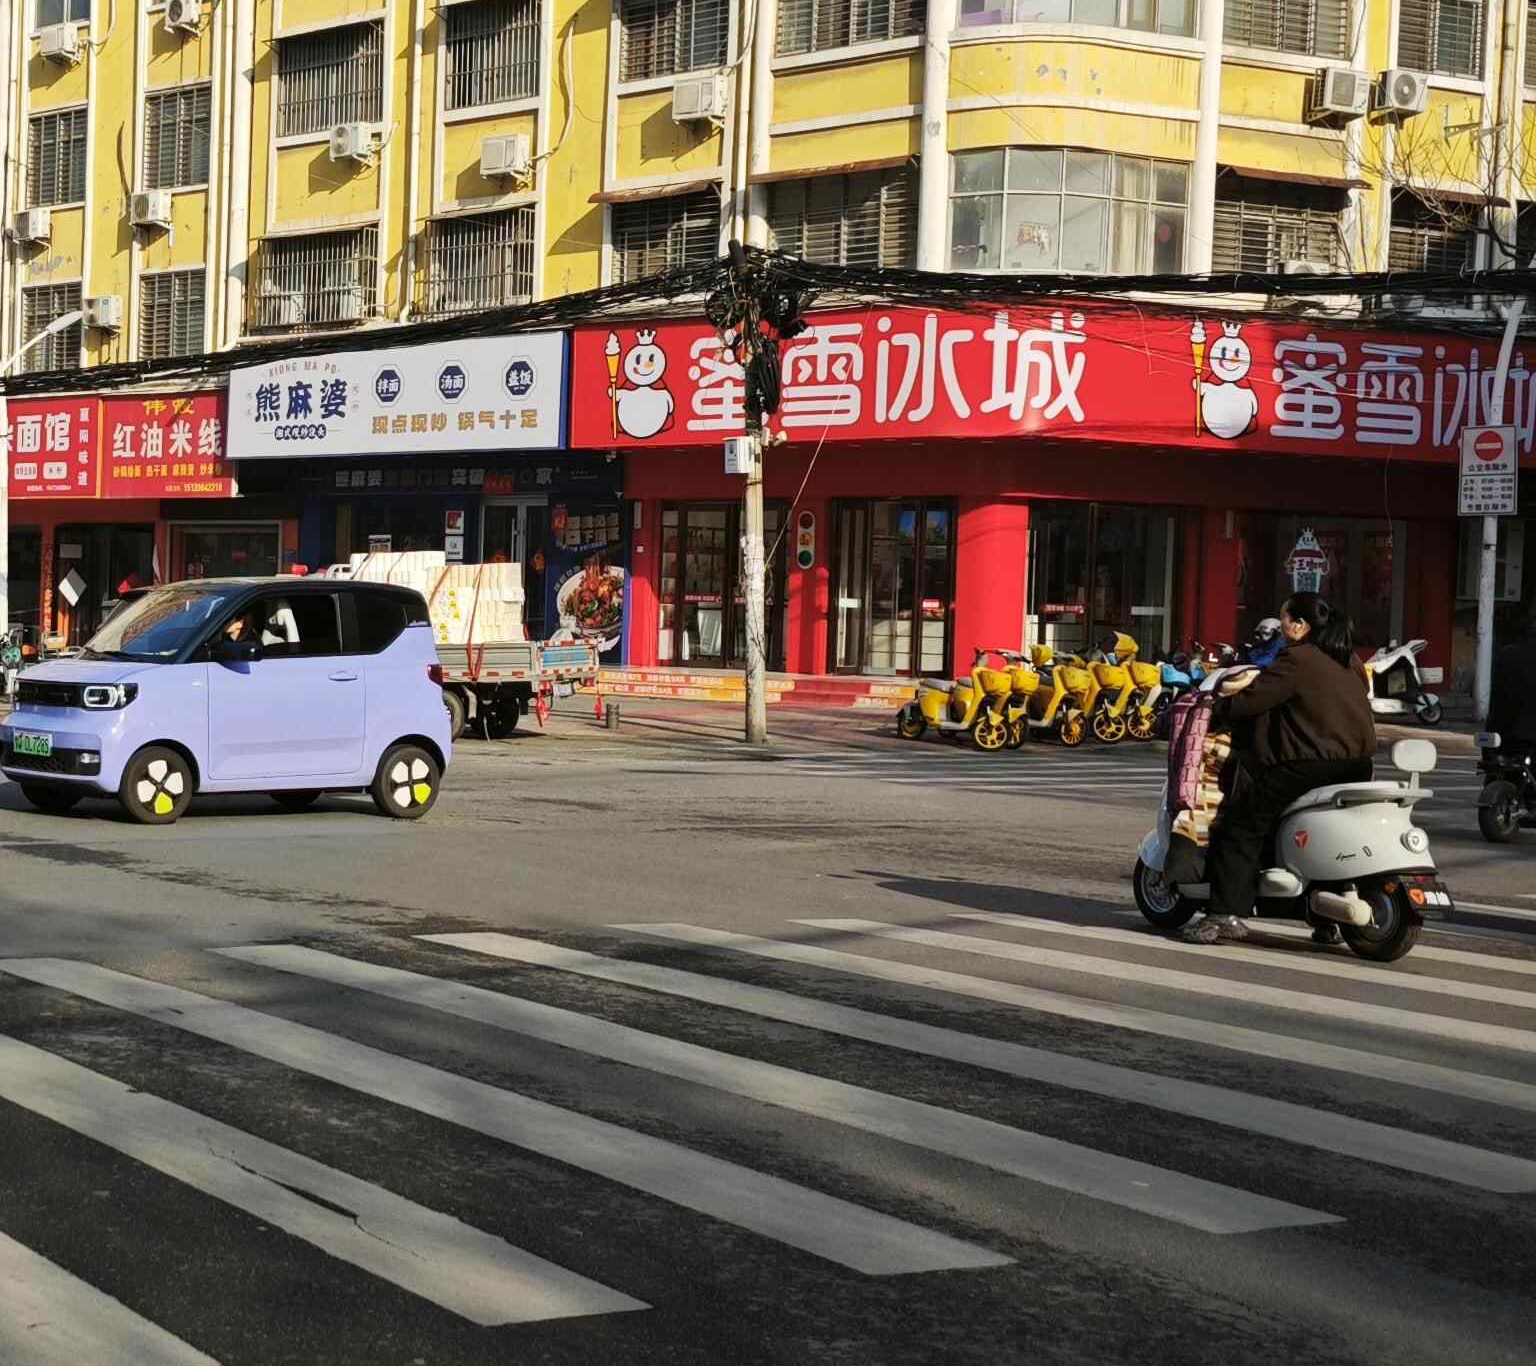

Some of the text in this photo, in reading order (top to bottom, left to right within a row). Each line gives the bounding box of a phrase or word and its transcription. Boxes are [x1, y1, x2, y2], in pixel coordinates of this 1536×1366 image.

[440, 374, 464, 390] 汤面
[686, 311, 1088, 432] 蜜雪冰城
[254, 378, 348, 422] 熊麻婆
[112, 418, 222, 459] 红油米线
[372, 409, 538, 434] 现点现炒 锅气十足
